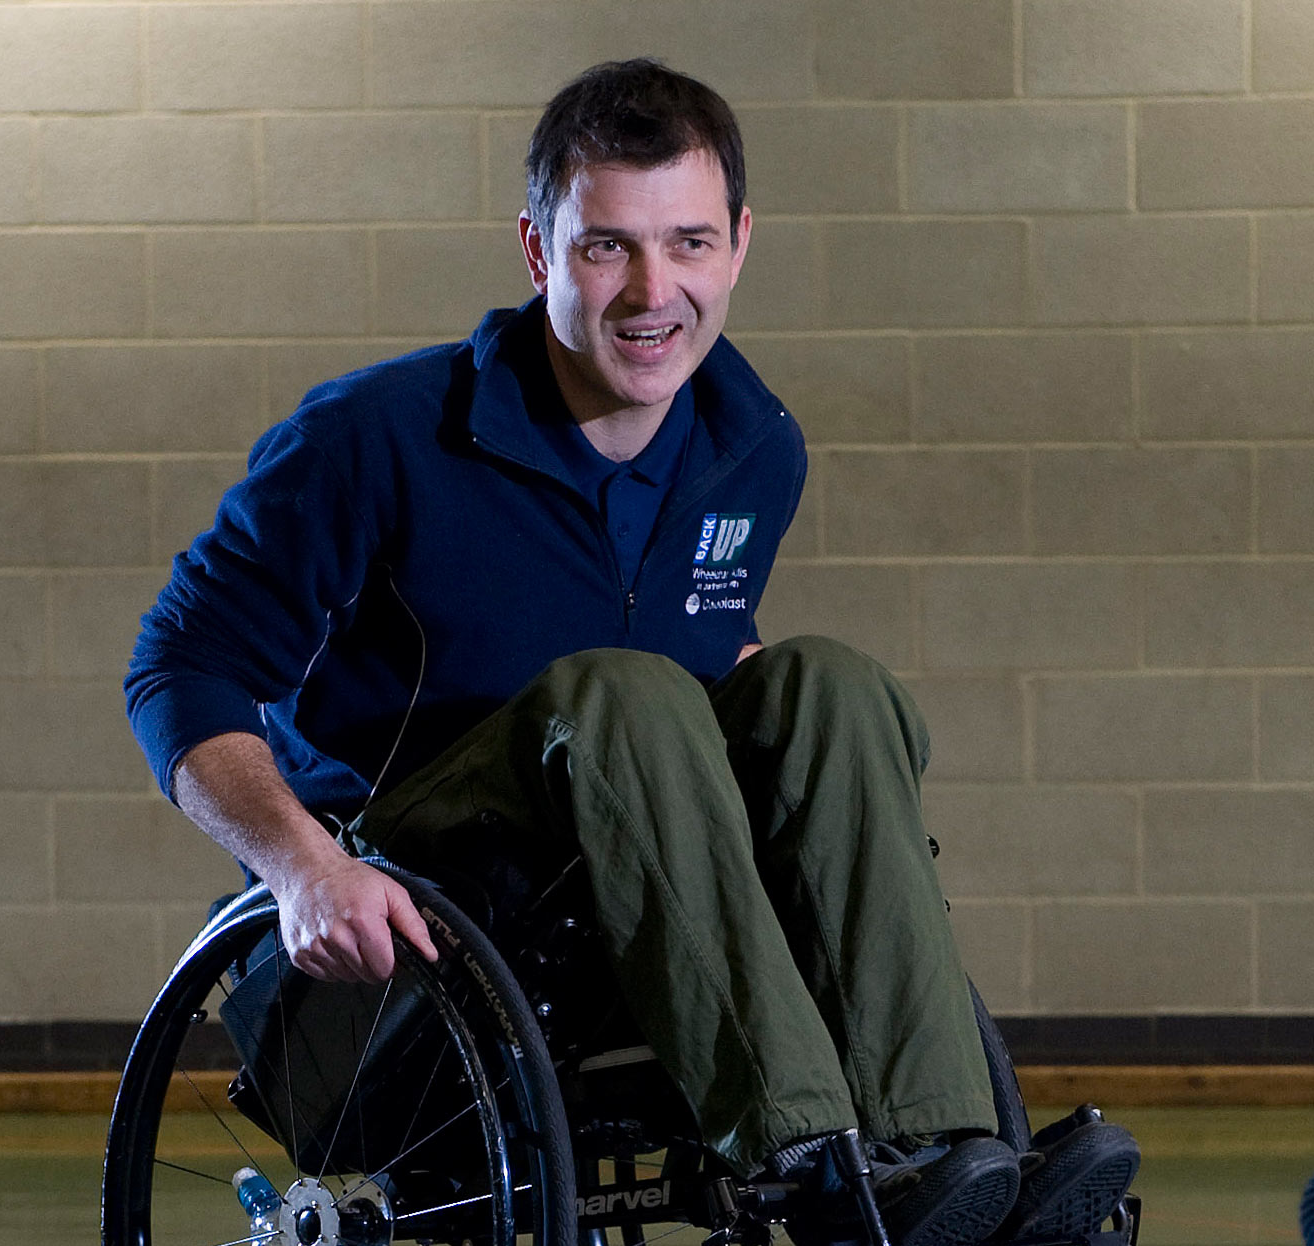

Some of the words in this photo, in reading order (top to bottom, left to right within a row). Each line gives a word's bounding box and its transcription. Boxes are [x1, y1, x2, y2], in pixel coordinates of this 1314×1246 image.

[694, 516, 716, 561] BACK
[712, 518, 750, 562] UP
[421, 906, 462, 947] PLUS
